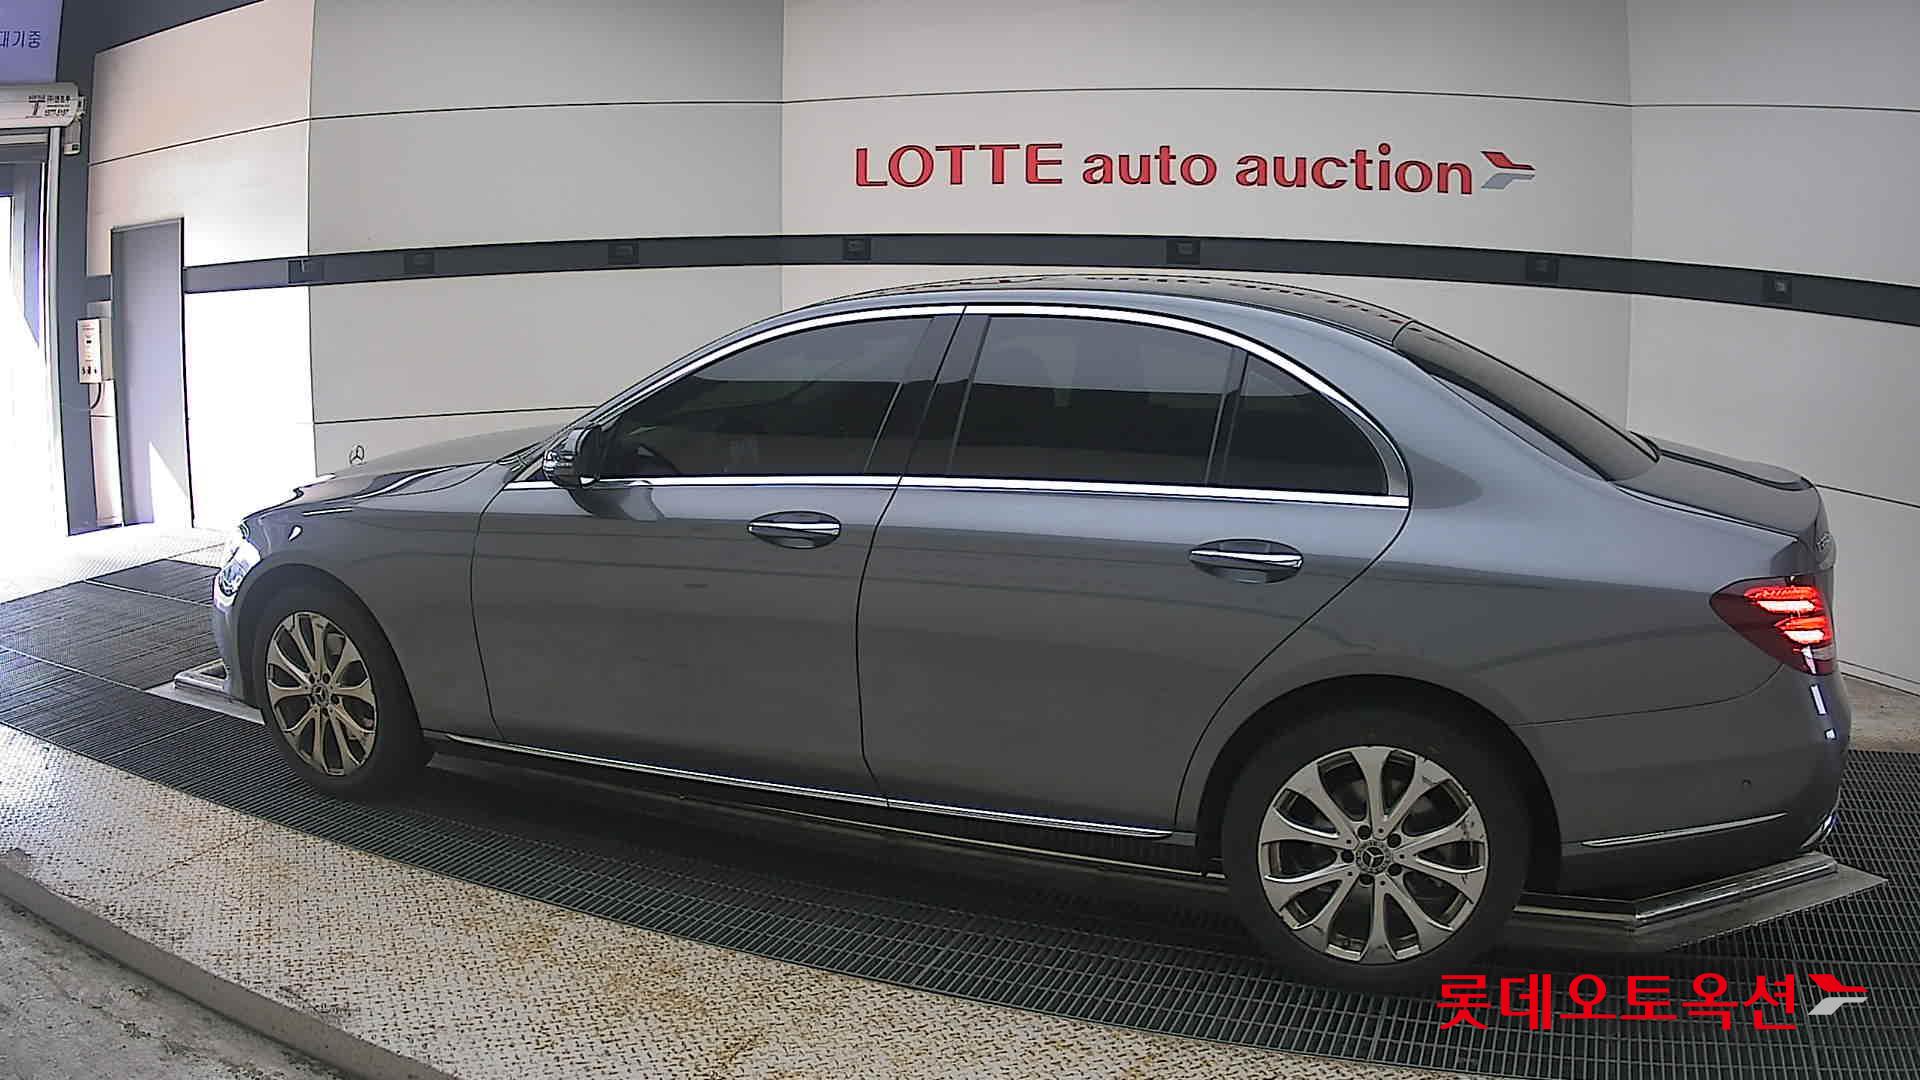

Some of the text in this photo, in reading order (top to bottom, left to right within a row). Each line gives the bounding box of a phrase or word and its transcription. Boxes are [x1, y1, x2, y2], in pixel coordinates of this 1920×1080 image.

[854, 143, 1474, 194] LOTTE auto auction
